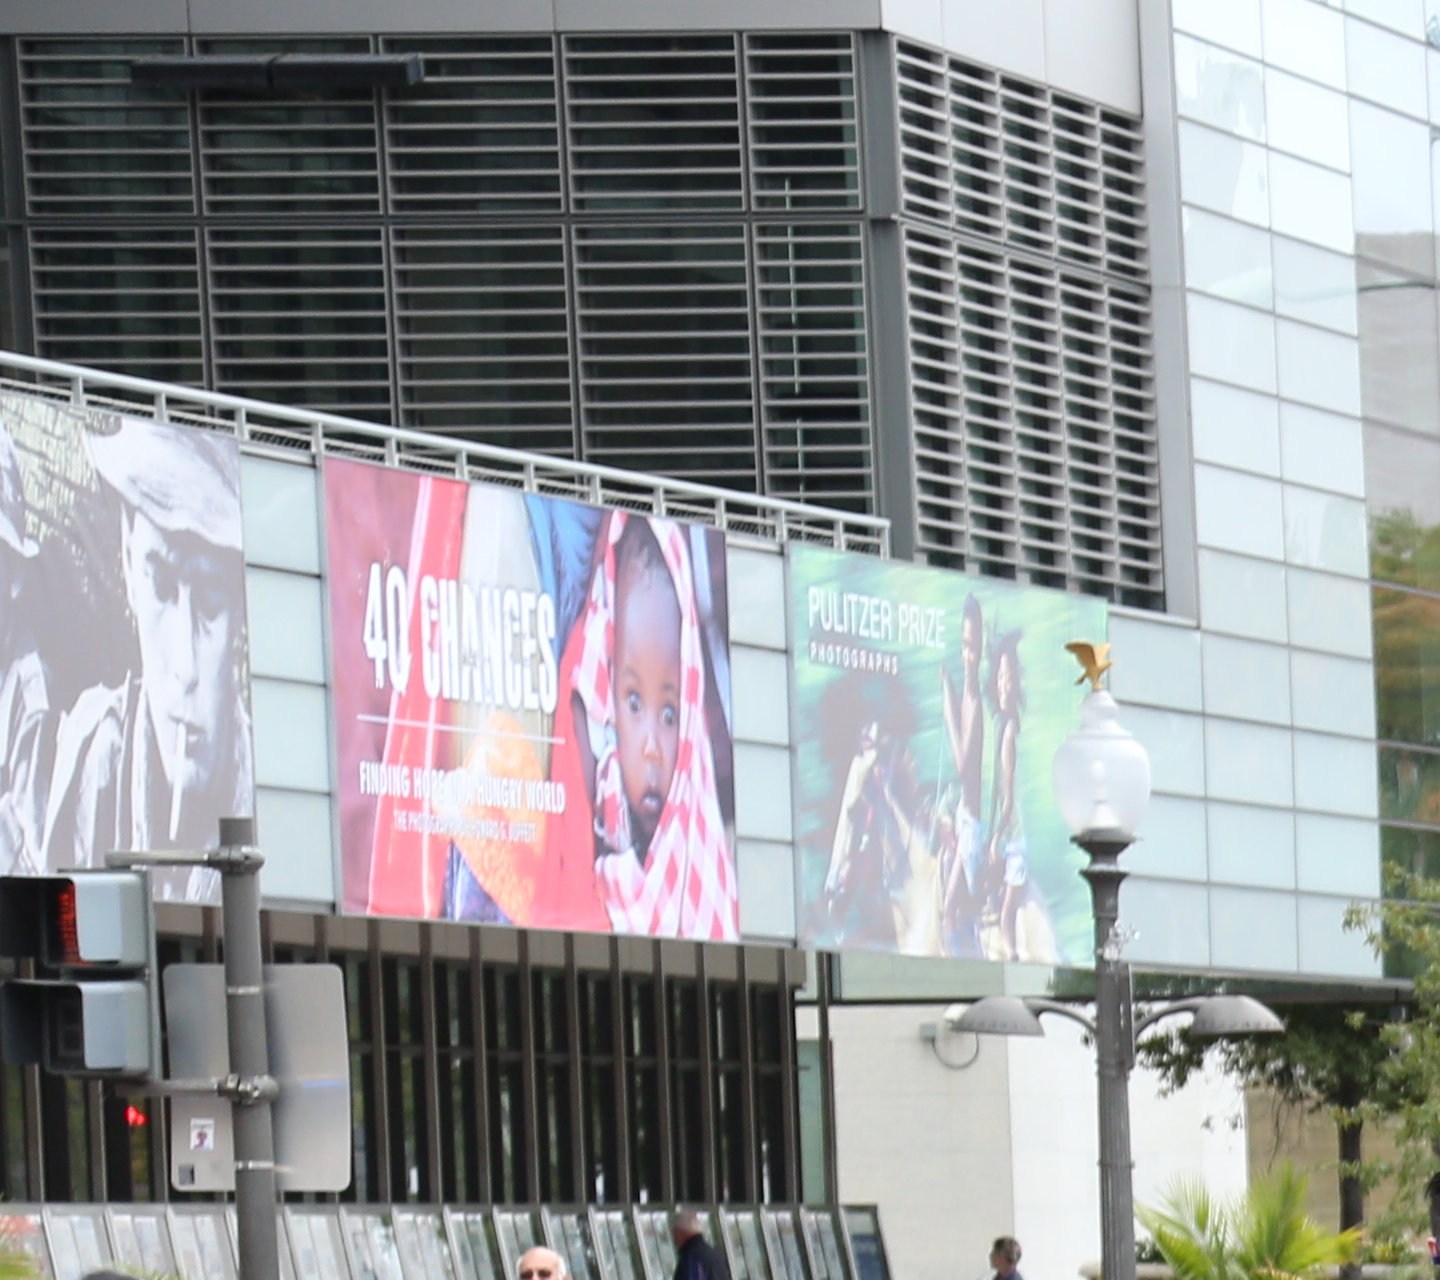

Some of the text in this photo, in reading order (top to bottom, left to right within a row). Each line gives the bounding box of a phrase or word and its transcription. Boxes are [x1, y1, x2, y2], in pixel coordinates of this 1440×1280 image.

[363, 562, 558, 714] 40 CHANCES
[808, 586, 946, 649] PULITZER PRIZE
[810, 641, 898, 676] PHOTOGRAPHS
[359, 760, 411, 798] FINDING
[478, 776, 522, 809] HUNGRY
[525, 780, 566, 814] WORLD
